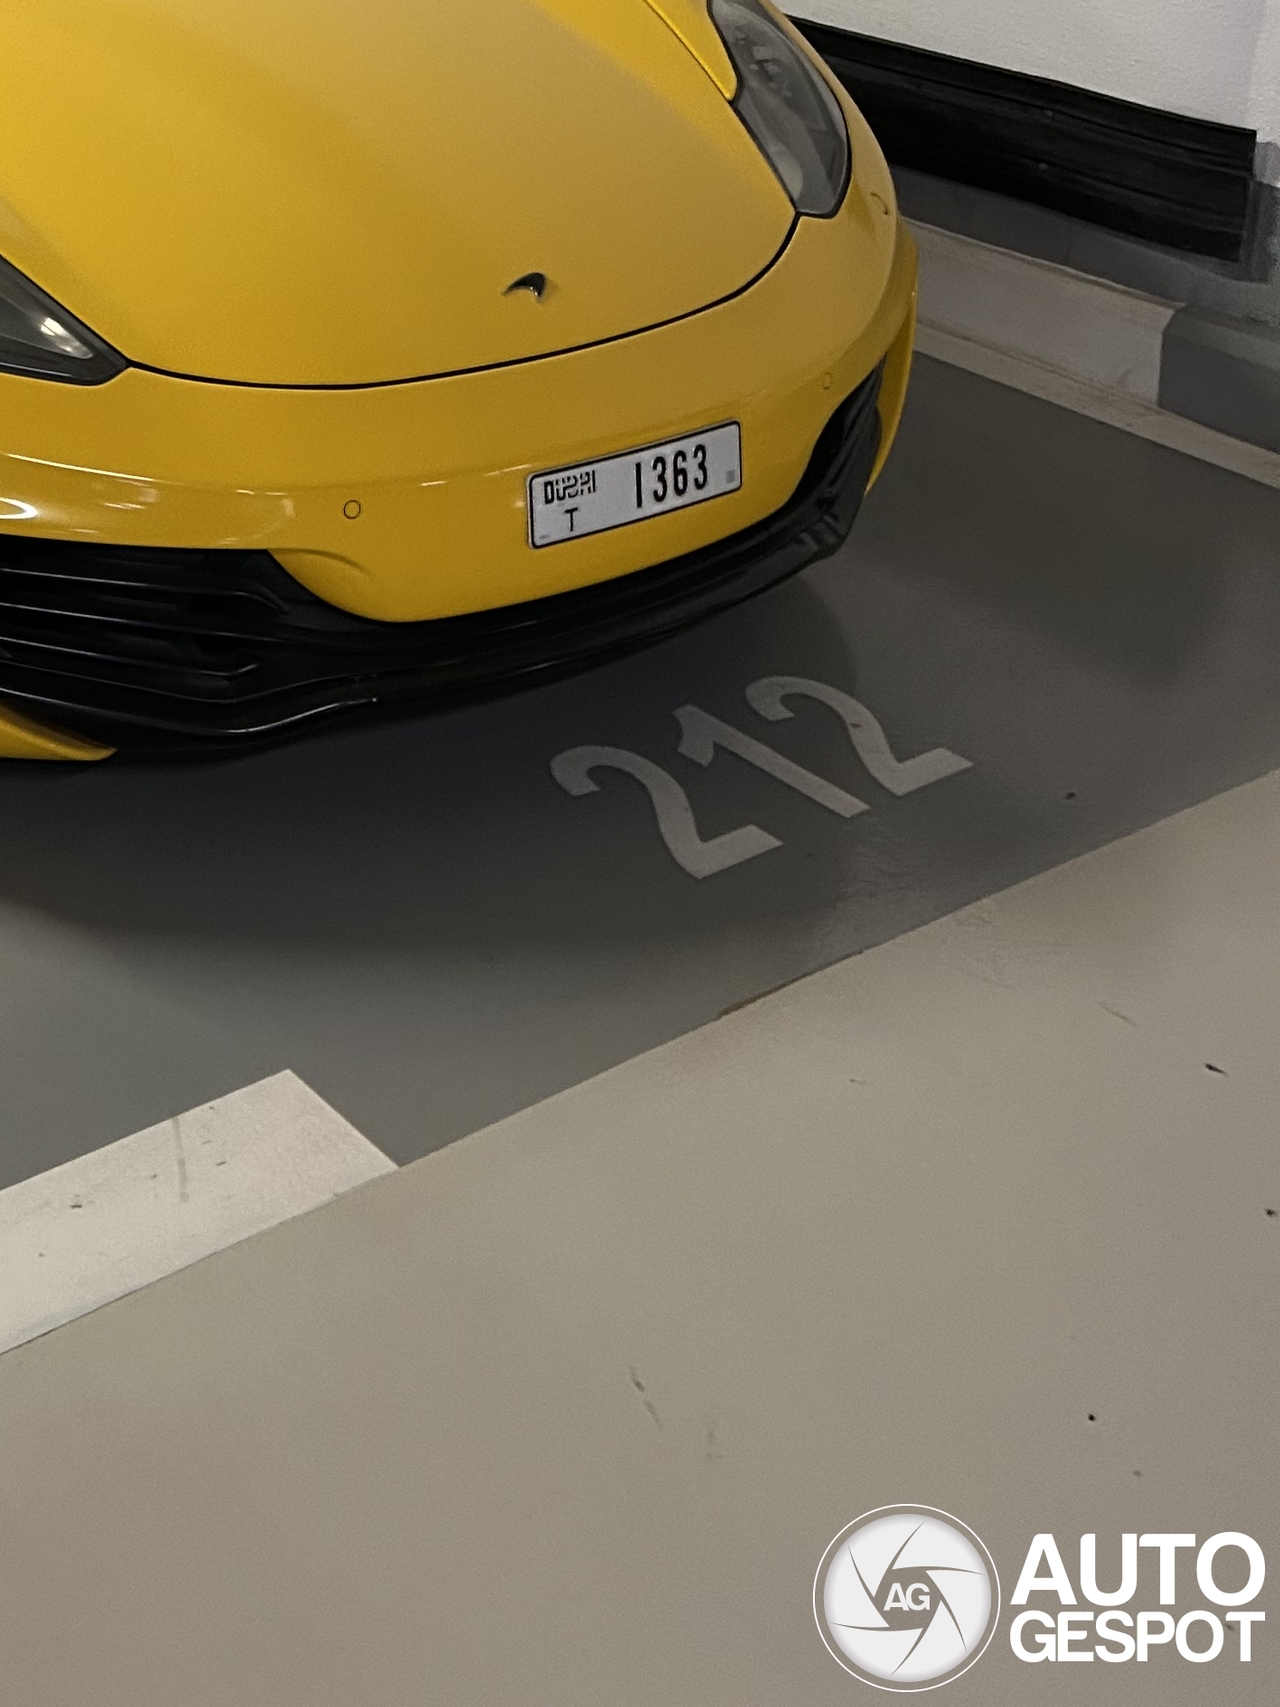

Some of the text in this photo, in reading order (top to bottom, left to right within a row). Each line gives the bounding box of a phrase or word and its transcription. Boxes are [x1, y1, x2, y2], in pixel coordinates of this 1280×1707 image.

[634, 444, 708, 508] 1363
[564, 507, 578, 532] T
[550, 676, 974, 879] 212
